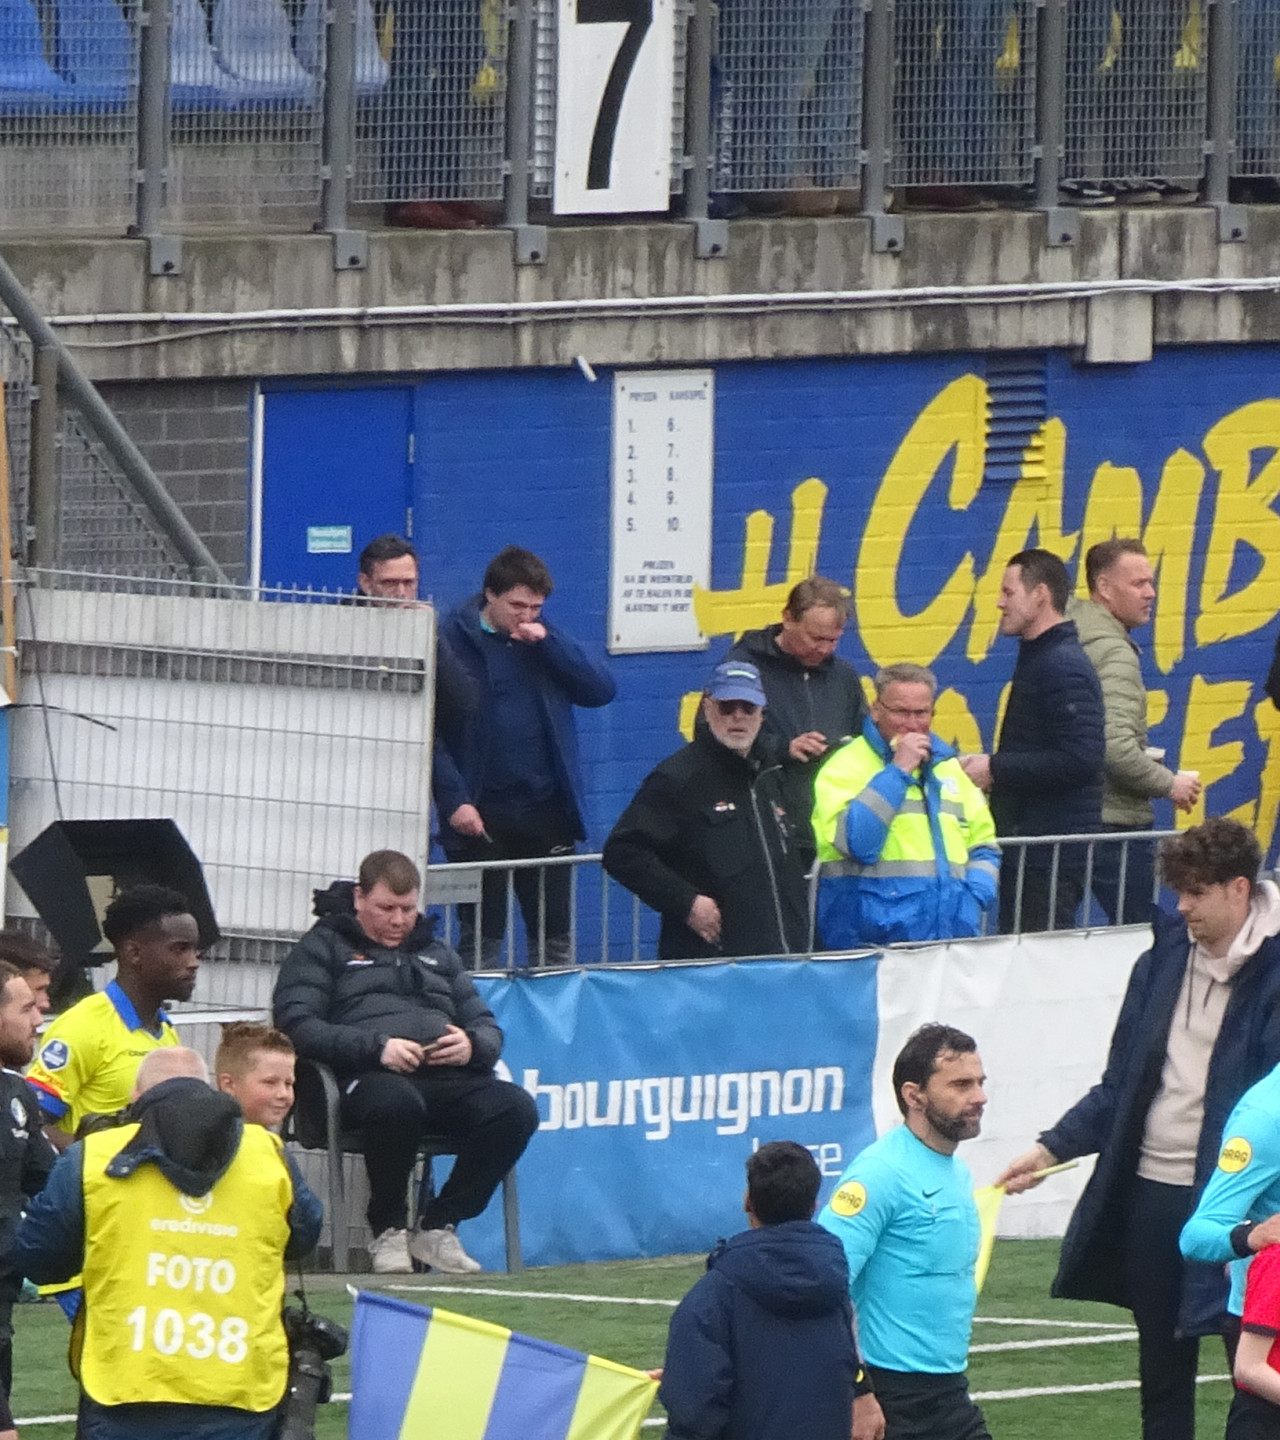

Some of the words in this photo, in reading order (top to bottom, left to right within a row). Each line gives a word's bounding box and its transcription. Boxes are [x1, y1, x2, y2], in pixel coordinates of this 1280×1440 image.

[577, 0, 653, 190] 7
[522, 1066, 845, 1141] bourguignon
[1222, 1149, 1248, 1163] ARAG
[837, 1190, 863, 1209] ARAG
[146, 1252, 236, 1294] FOTO
[127, 1305, 248, 1364] 1038
